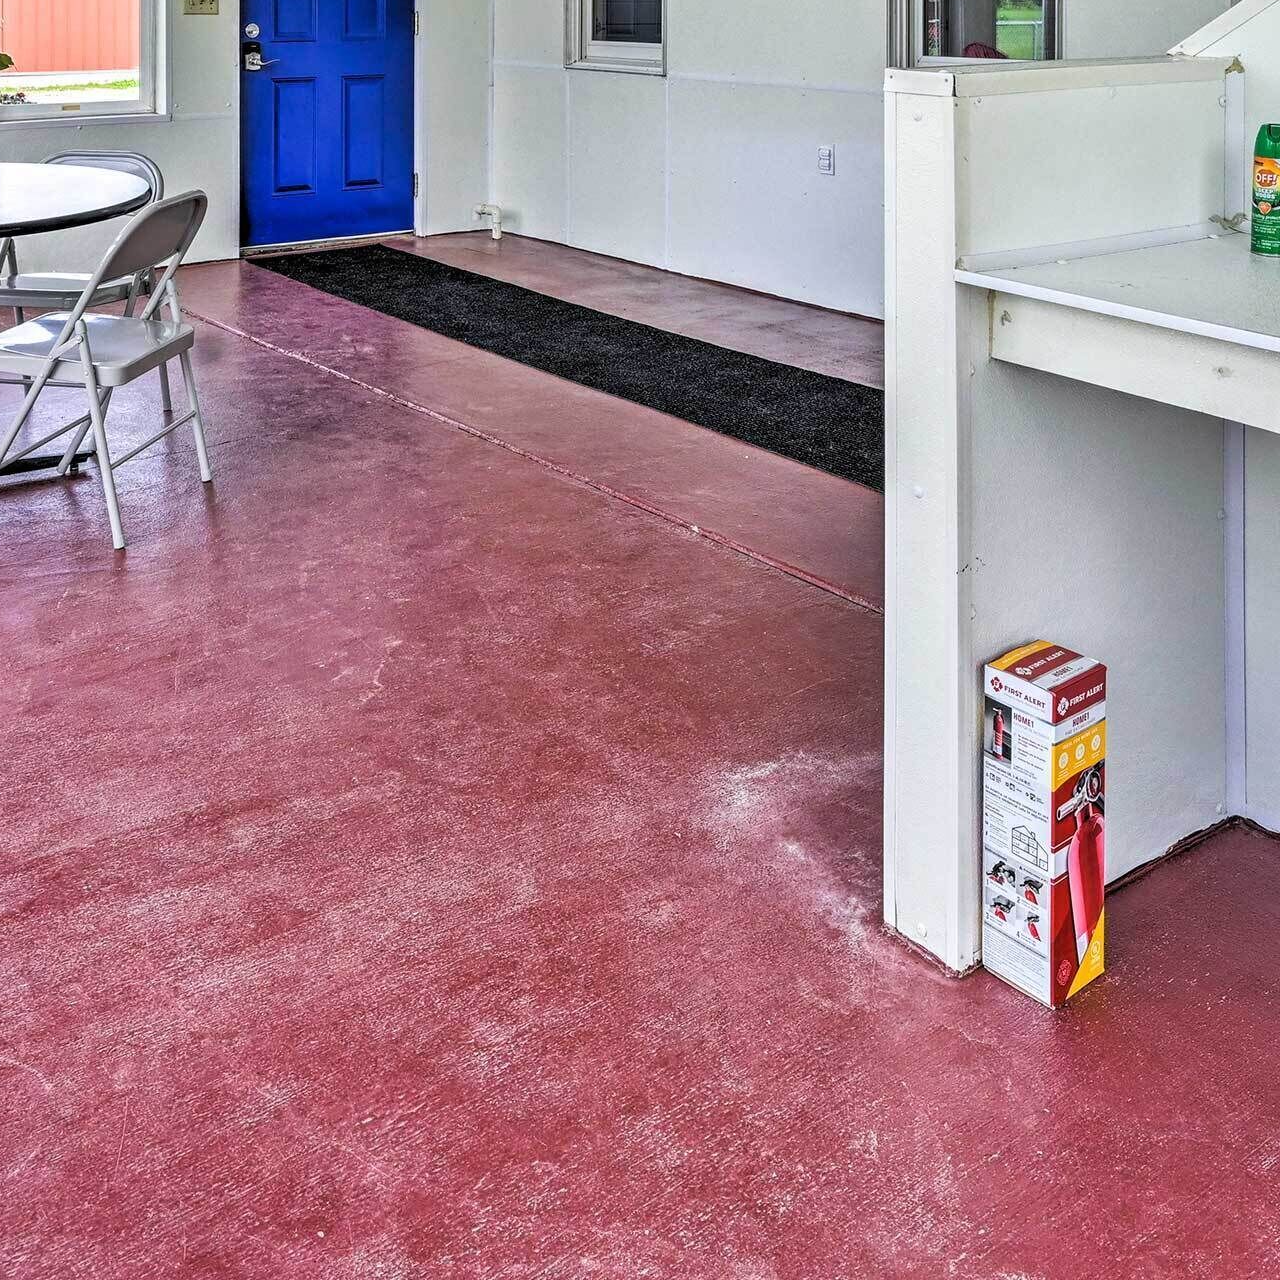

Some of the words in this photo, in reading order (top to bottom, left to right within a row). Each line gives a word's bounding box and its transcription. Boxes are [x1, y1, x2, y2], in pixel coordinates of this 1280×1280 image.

[1255, 173, 1277, 185] OFF!
[1004, 685, 1022, 699] FIRST
[1024, 694, 1046, 709] ALERT
[1069, 692, 1086, 707] FIRST
[1086, 683, 1103, 698] ALERT
[1013, 712, 1034, 729] HOME1
